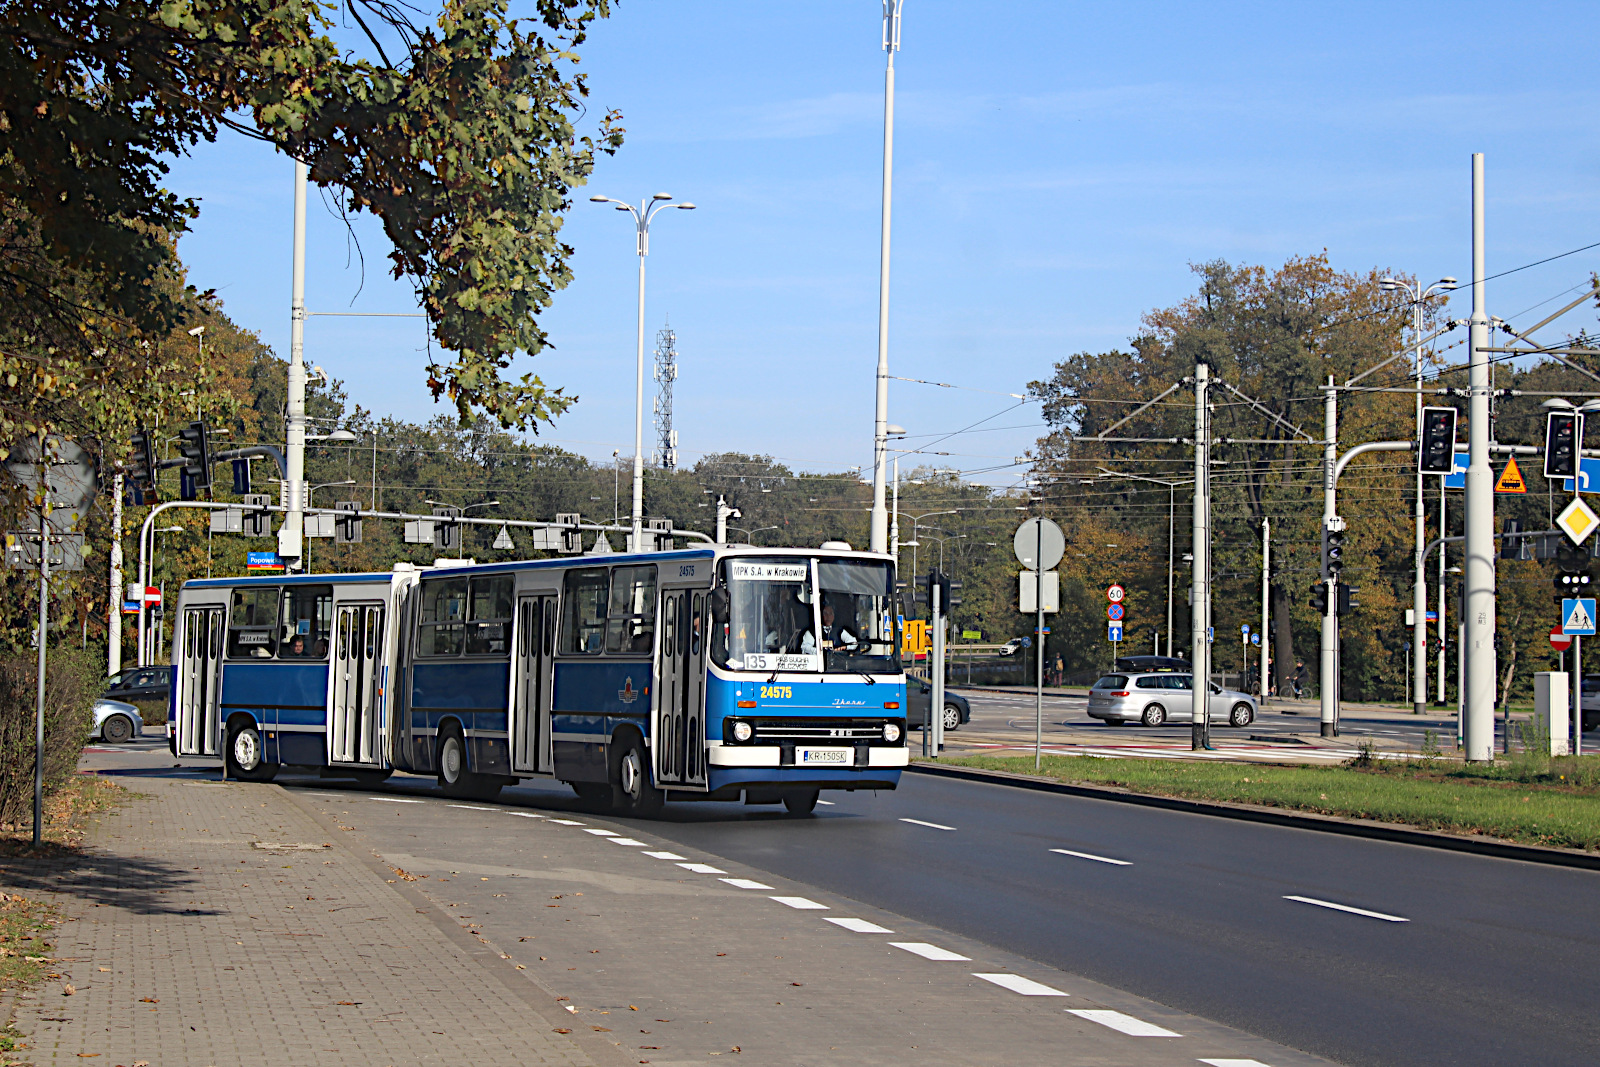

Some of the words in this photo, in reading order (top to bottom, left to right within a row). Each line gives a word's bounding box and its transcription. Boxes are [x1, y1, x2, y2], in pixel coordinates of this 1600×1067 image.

[679, 565, 695, 577] 24575
[734, 566, 749, 577] MPK
[750, 566, 764, 577] S.A.
[766, 568, 773, 577] w
[774, 567, 805, 577] Krakowie
[1109, 589, 1122, 599] 60
[745, 654, 767, 669] 135
[760, 685, 792, 698] 24575
[808, 752, 820, 760] KR
